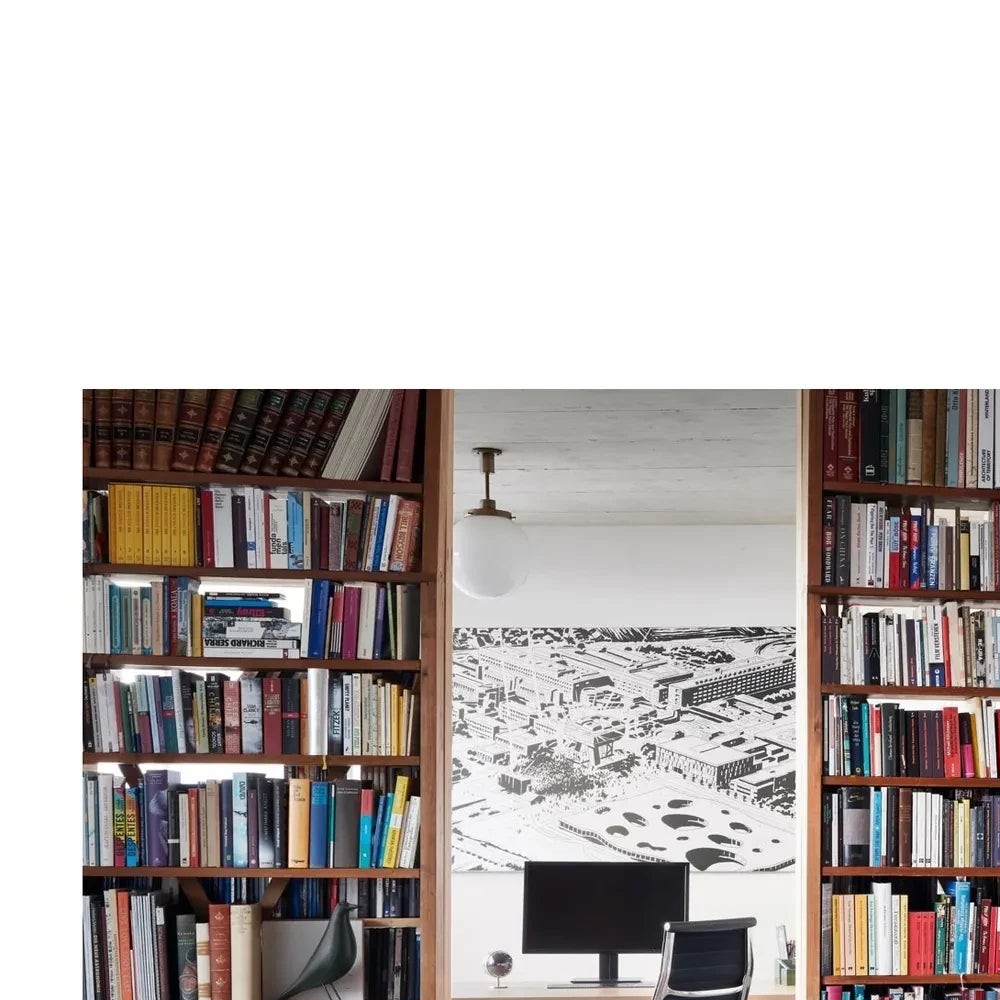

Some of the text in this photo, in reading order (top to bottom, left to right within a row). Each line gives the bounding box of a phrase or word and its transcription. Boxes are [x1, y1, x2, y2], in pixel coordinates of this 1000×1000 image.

[396, 516, 408, 559] BILL BRYSON
[204, 639, 265, 647] RICHARD SERRA
[115, 813, 125, 856] DESPENTES
[127, 814, 136, 856] DESPENTES
